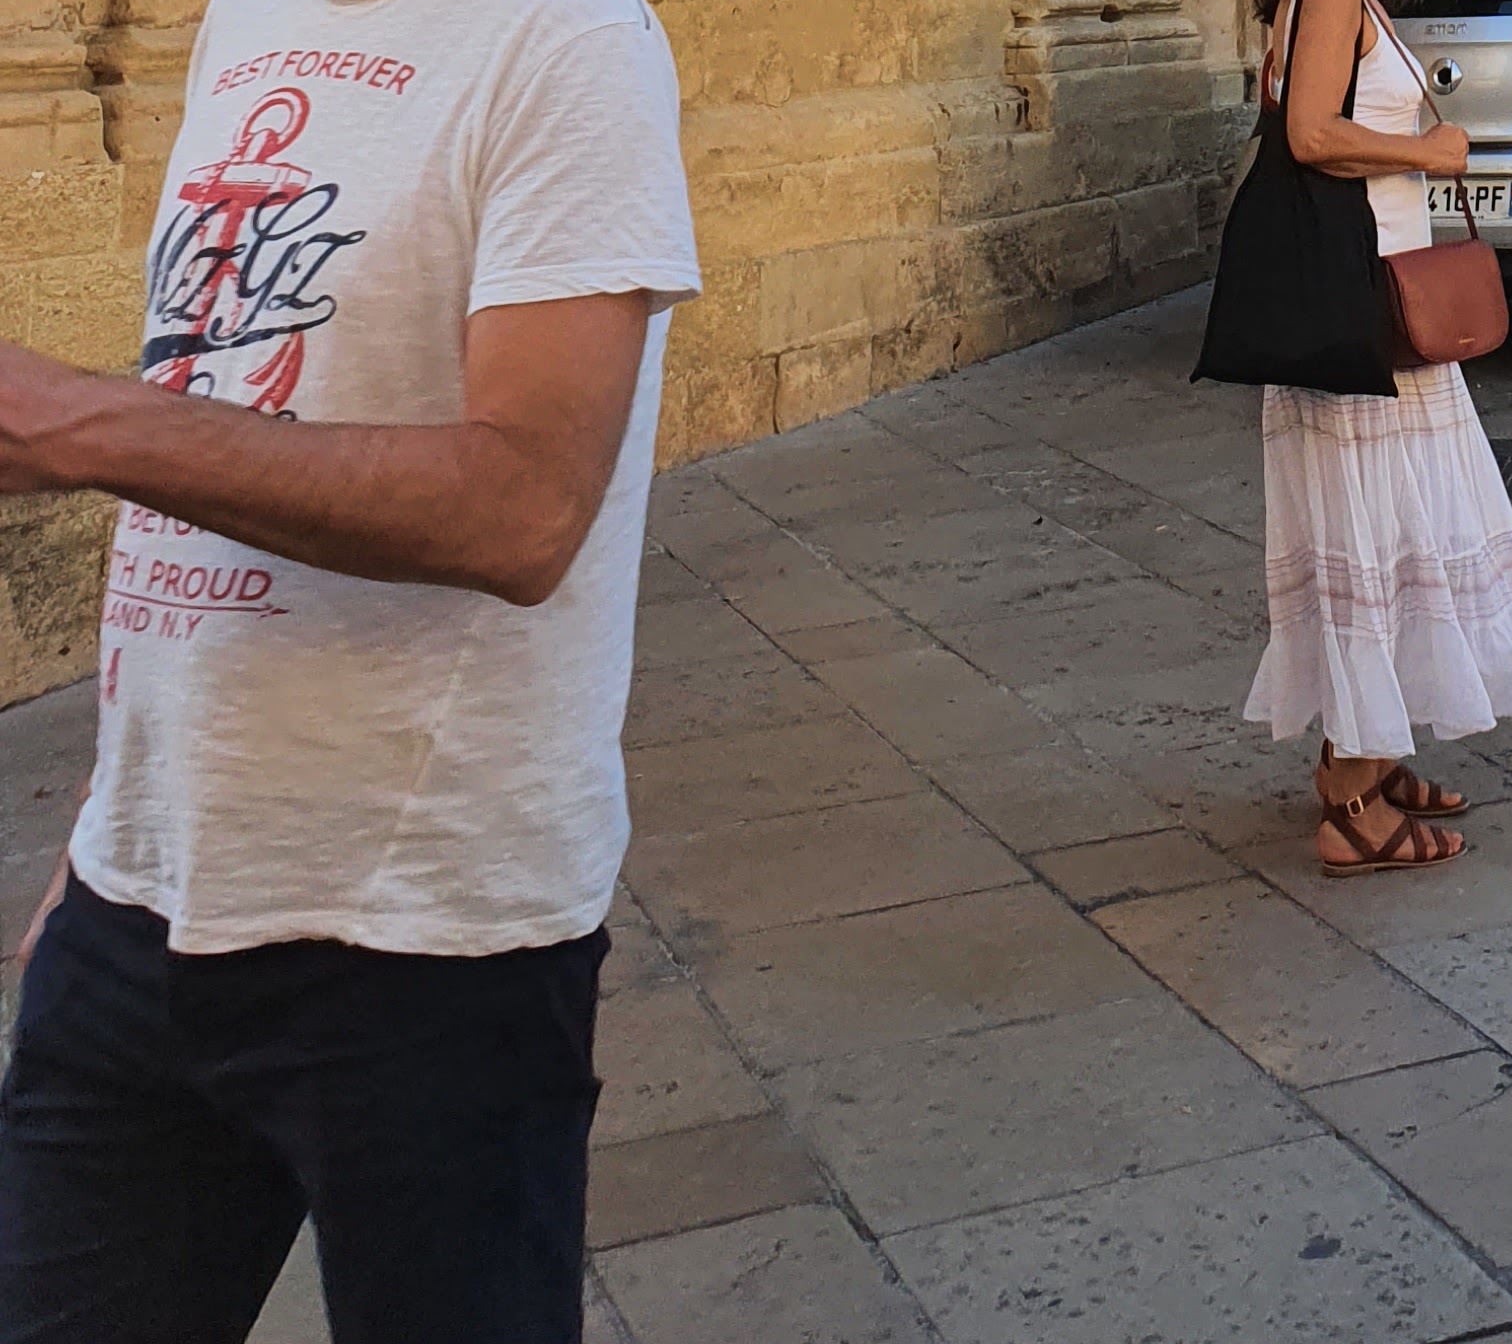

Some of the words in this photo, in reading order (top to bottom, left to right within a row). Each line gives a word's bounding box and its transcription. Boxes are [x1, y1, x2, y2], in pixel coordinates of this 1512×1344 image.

[211, 50, 283, 96] BEST
[277, 50, 416, 96] FOREVER
[147, 559, 273, 602] PROUD
